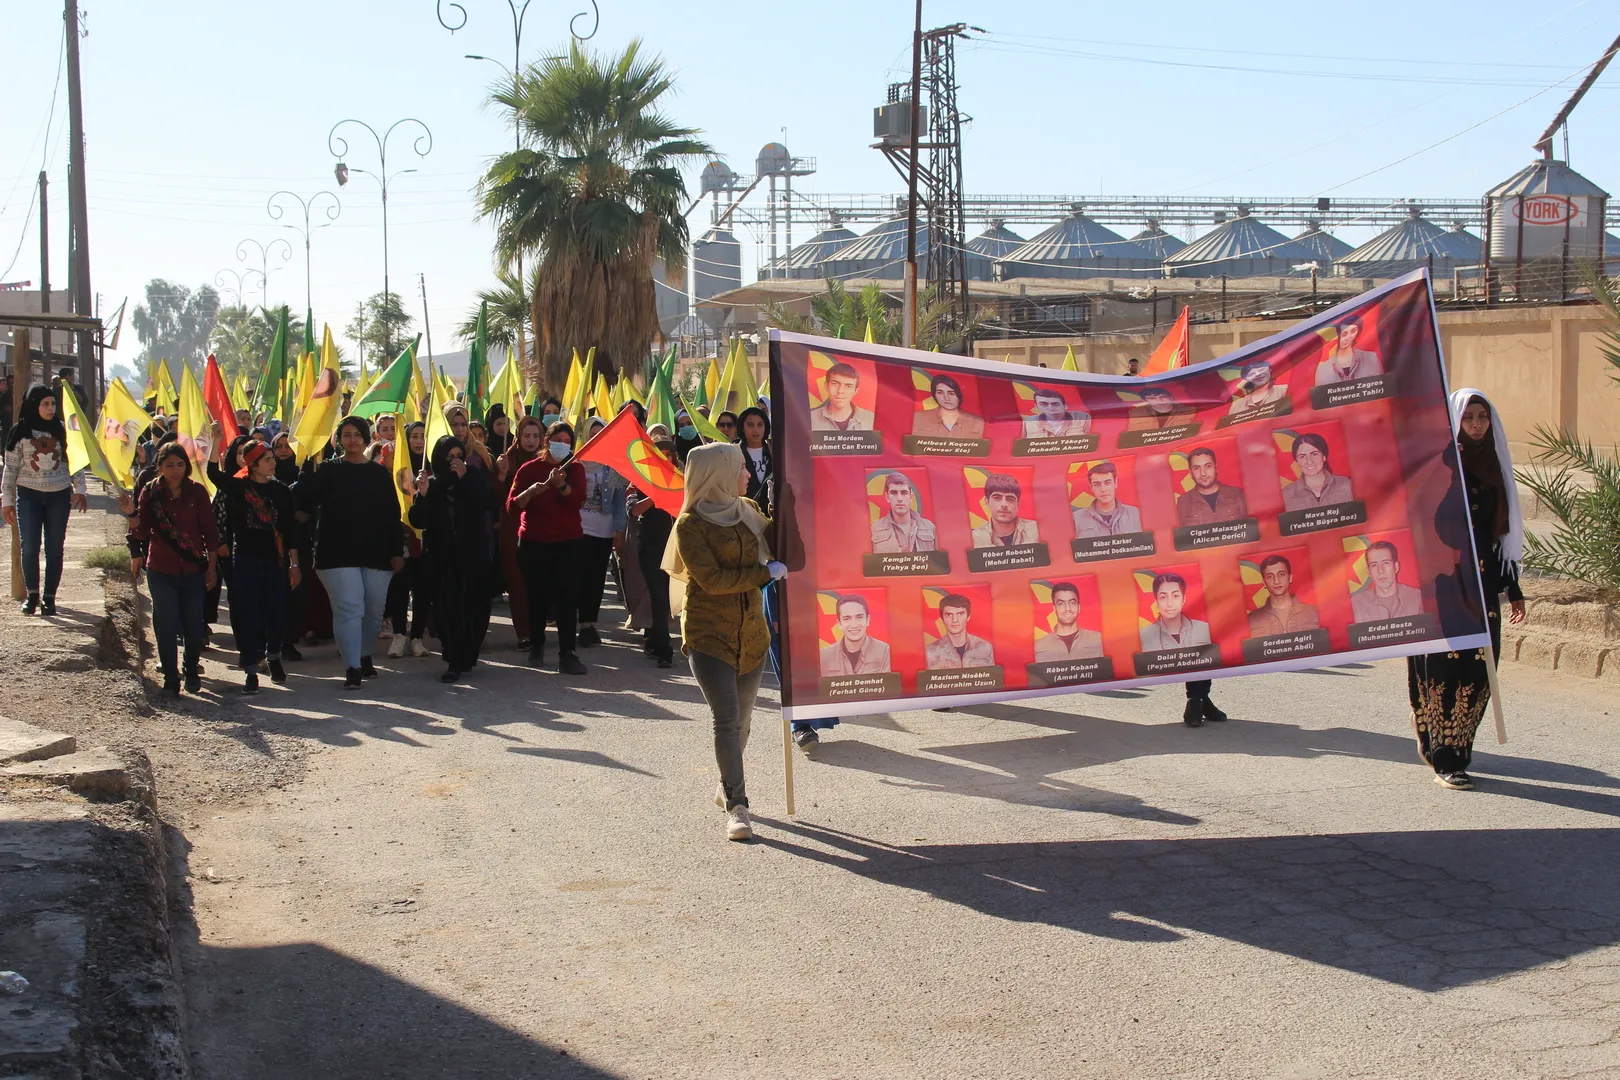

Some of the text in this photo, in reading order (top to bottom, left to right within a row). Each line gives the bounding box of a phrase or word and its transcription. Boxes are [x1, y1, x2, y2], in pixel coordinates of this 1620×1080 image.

[1525, 202, 1560, 218] YORK
[1357, 380, 1382, 389] Zagros
[1329, 388, 1384, 403] (Newroz Tahir)
[1327, 508, 1340, 516] Roj
[1290, 522, 1314, 531] (Yekta
[1340, 513, 1357, 521] Boz)
[1193, 532, 1246, 545] (Alican Derici)
[1074, 549, 1110, 559] (Muhammed
[984, 556, 1034, 568] (Mehdi Babat)
[883, 564, 908, 572] (Yahya
[1368, 622, 1412, 632] Erdal Besta
[1263, 638, 1292, 646] Serdem
[1358, 630, 1404, 644] (Muhammed
[1264, 643, 1314, 656] (Osman Abdi)
[1148, 656, 1212, 671] (Peyam Abdullah)
[1054, 674, 1078, 682] (Amed
[926, 682, 972, 690] (Abdurrahim
[830, 688, 856, 696] (Ferhat
